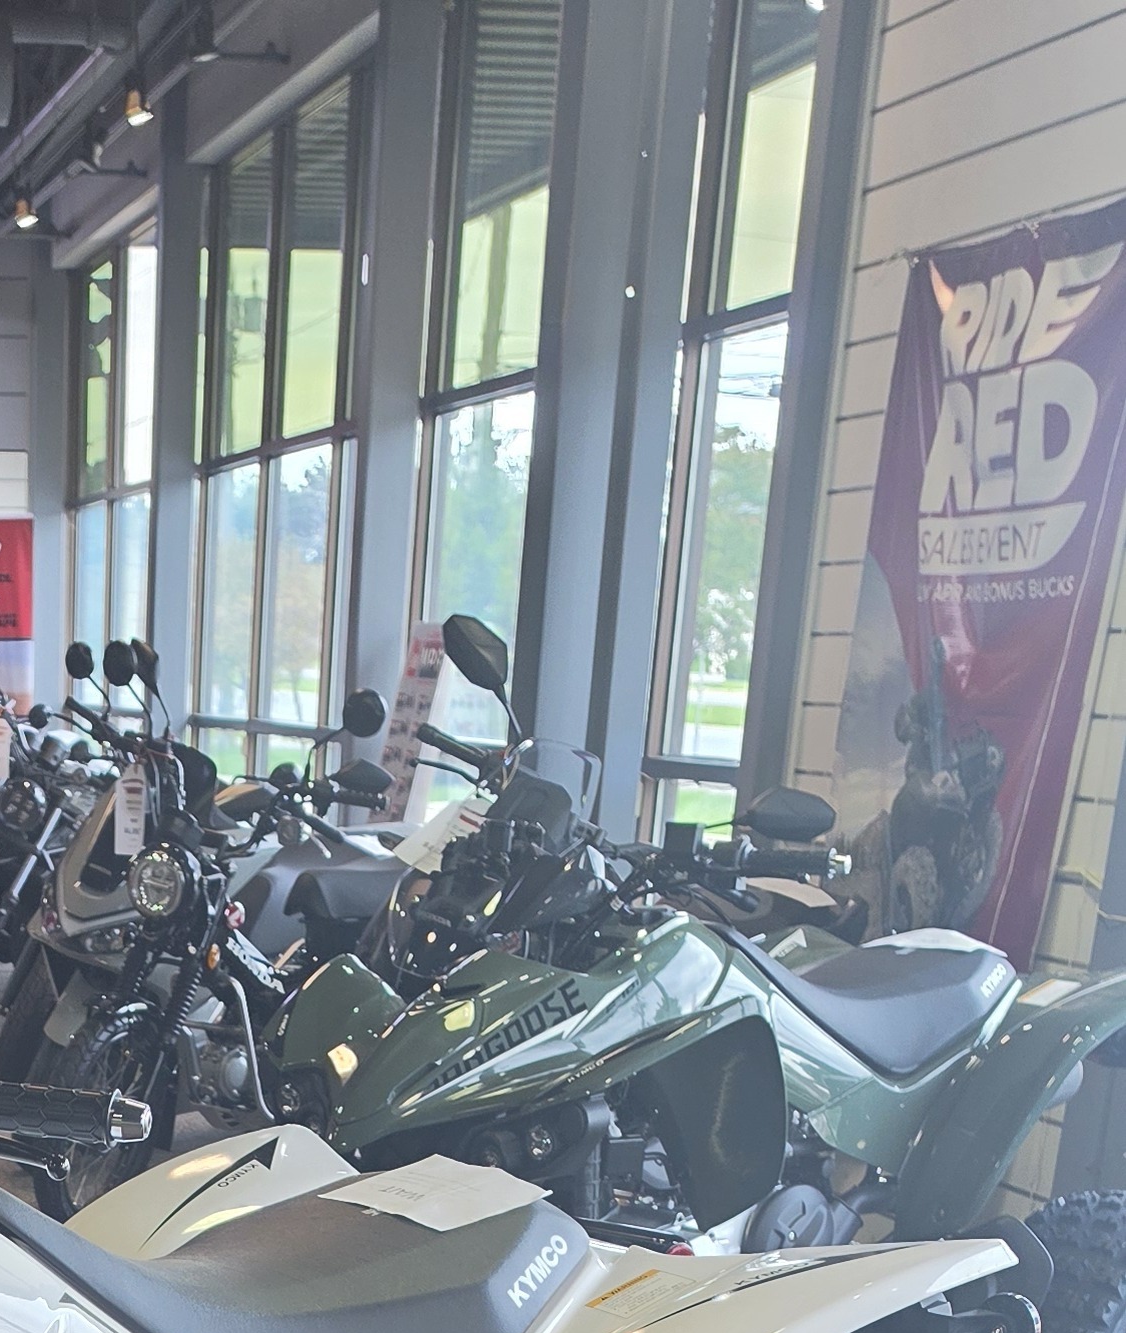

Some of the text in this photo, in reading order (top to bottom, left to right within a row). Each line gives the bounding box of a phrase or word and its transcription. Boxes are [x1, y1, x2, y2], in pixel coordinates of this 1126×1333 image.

[929, 242, 1124, 380] RIDE
[918, 358, 1099, 514] RED
[1027, 574, 1074, 599] BUCKS
[980, 963, 1007, 998] KYMCO
[506, 1234, 569, 1309] KYMCO
[733, 1260, 810, 1286] KYMCO
